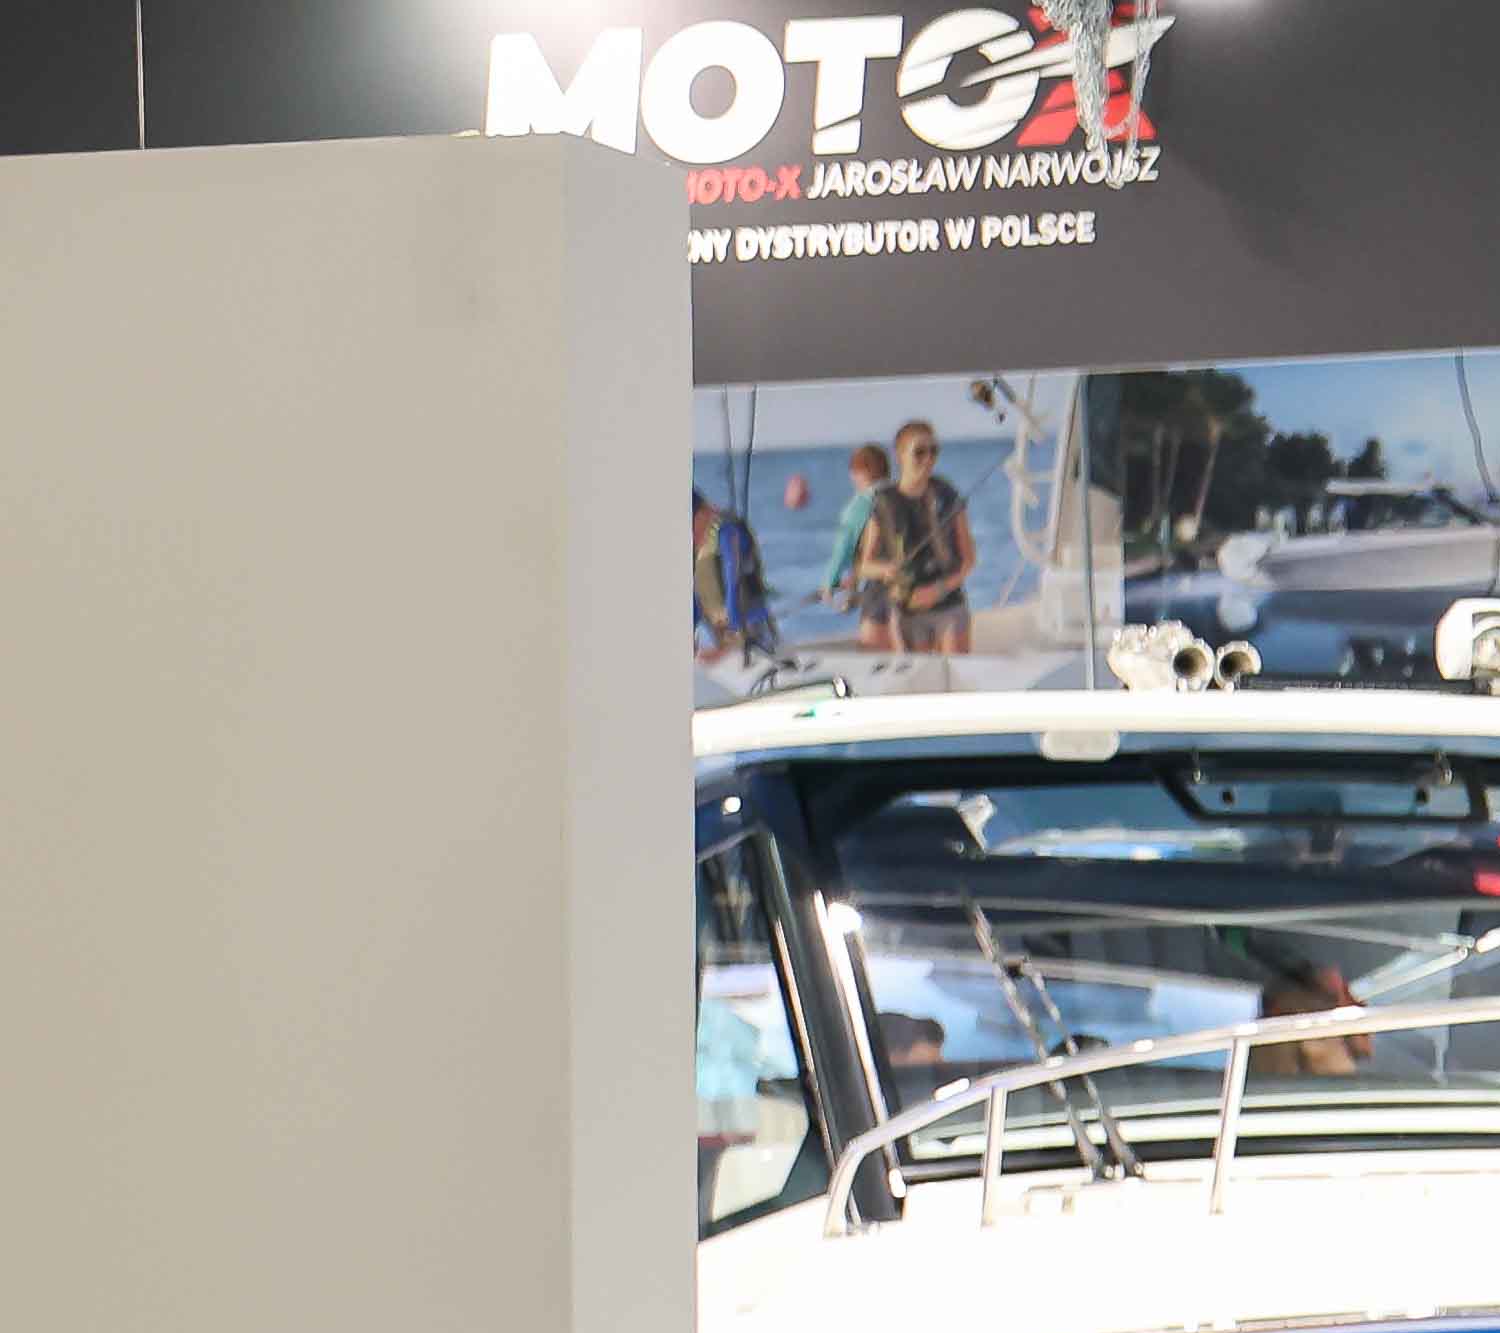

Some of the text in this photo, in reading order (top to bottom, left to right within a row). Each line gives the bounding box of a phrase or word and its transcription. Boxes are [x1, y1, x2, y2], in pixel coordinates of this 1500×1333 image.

[806, 154, 981, 199] JAROSŁAW
[687, 211, 1096, 263] NY DYSTRYBUTOR W POLSCE
